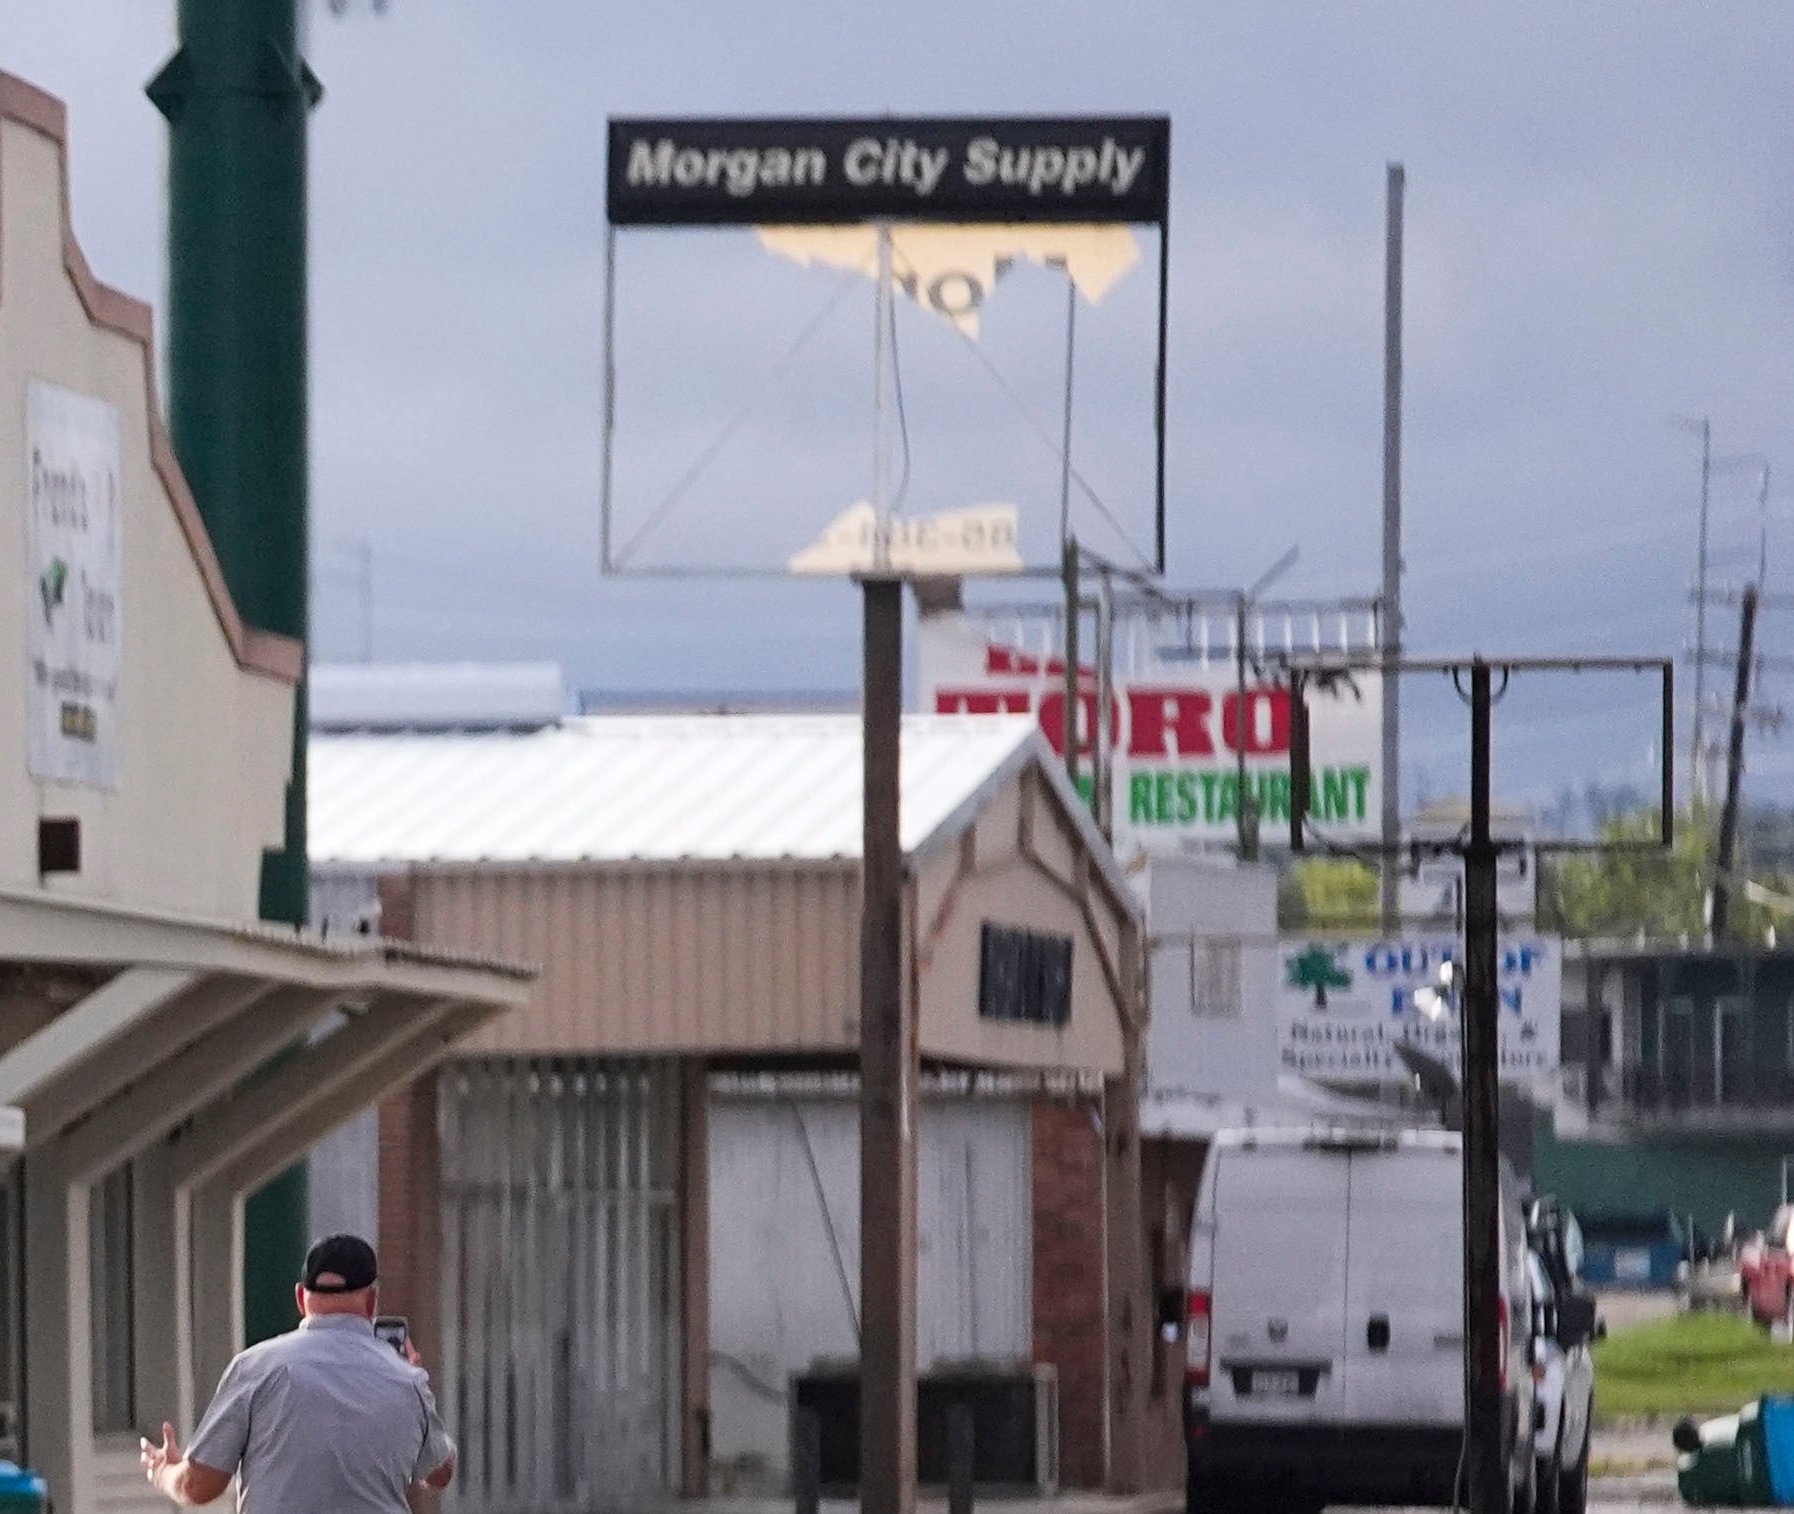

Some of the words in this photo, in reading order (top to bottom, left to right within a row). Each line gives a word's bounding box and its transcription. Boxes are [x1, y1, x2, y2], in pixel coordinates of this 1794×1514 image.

[626, 138, 827, 196] Morgan
[843, 138, 949, 195] City
[963, 137, 1144, 195] Supply
